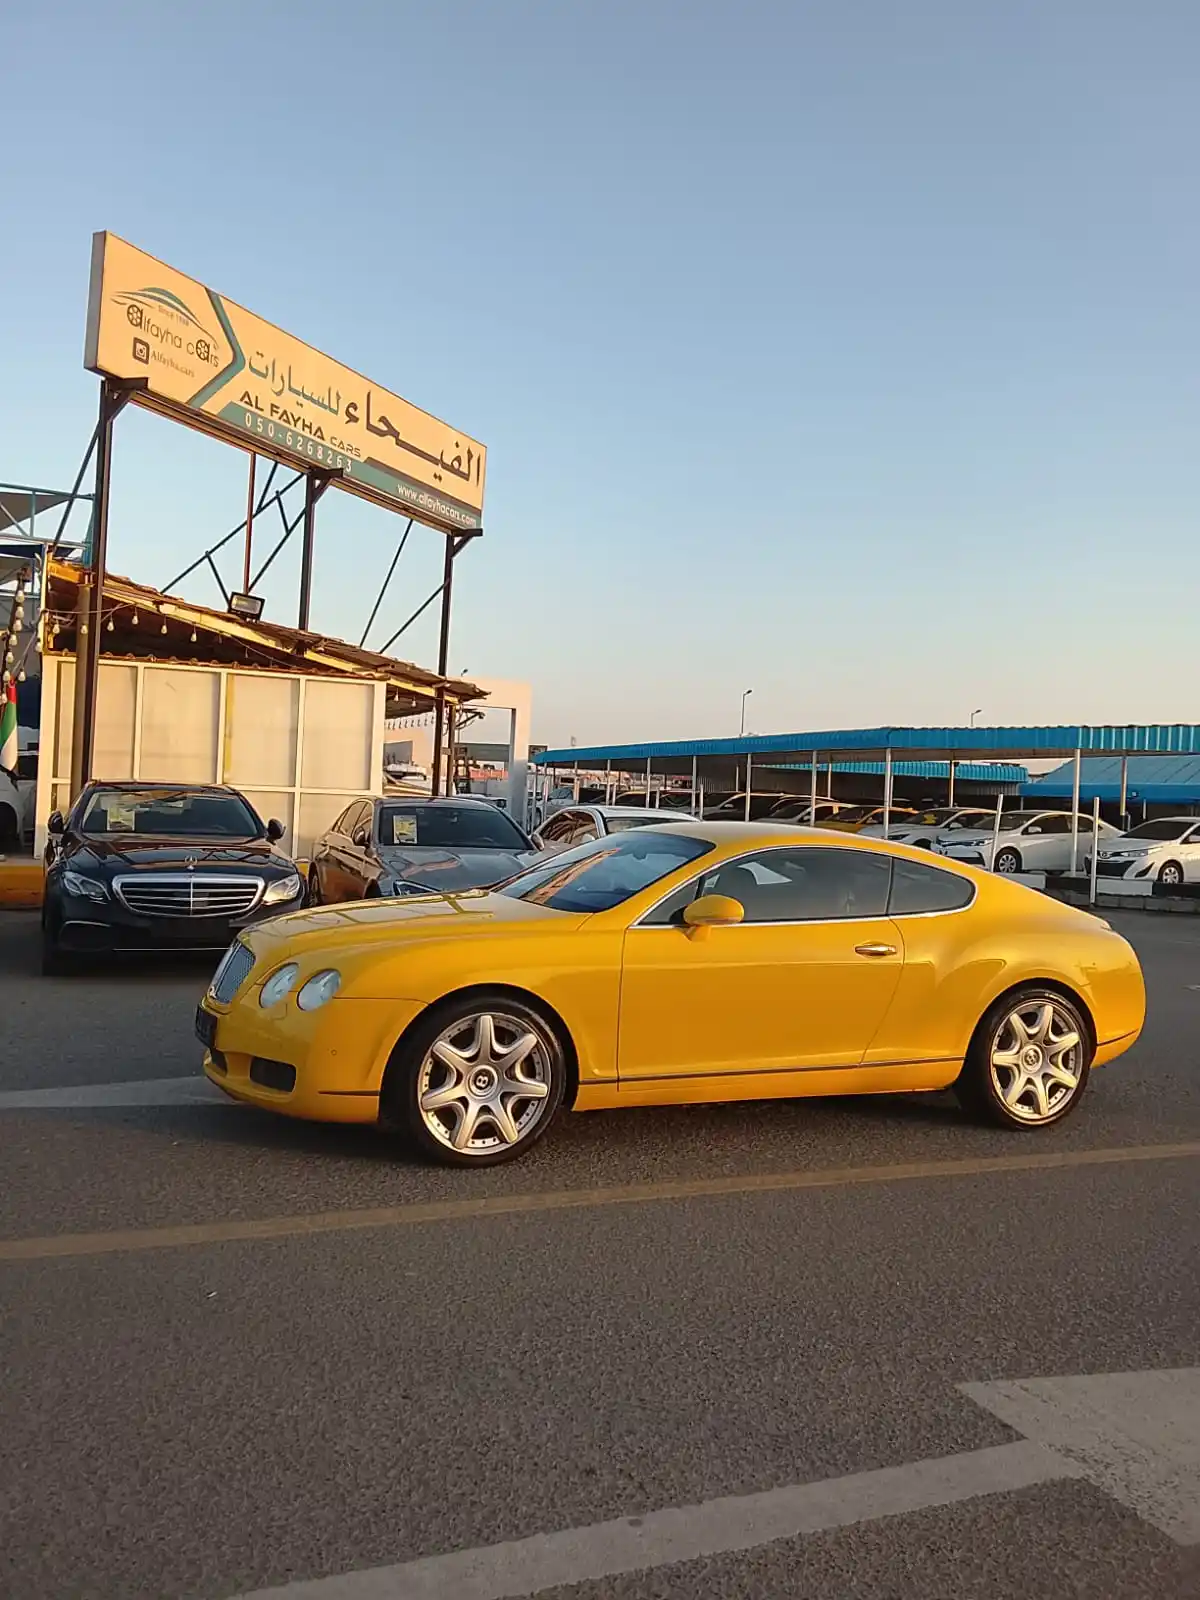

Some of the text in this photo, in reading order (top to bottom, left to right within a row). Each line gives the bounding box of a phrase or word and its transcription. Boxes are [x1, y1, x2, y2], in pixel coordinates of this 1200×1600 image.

[186, 339, 219, 368] cars
[239, 390, 361, 457] AL FAYHA CARS
[248, 350, 480, 486] الفيحاء للسيارات
